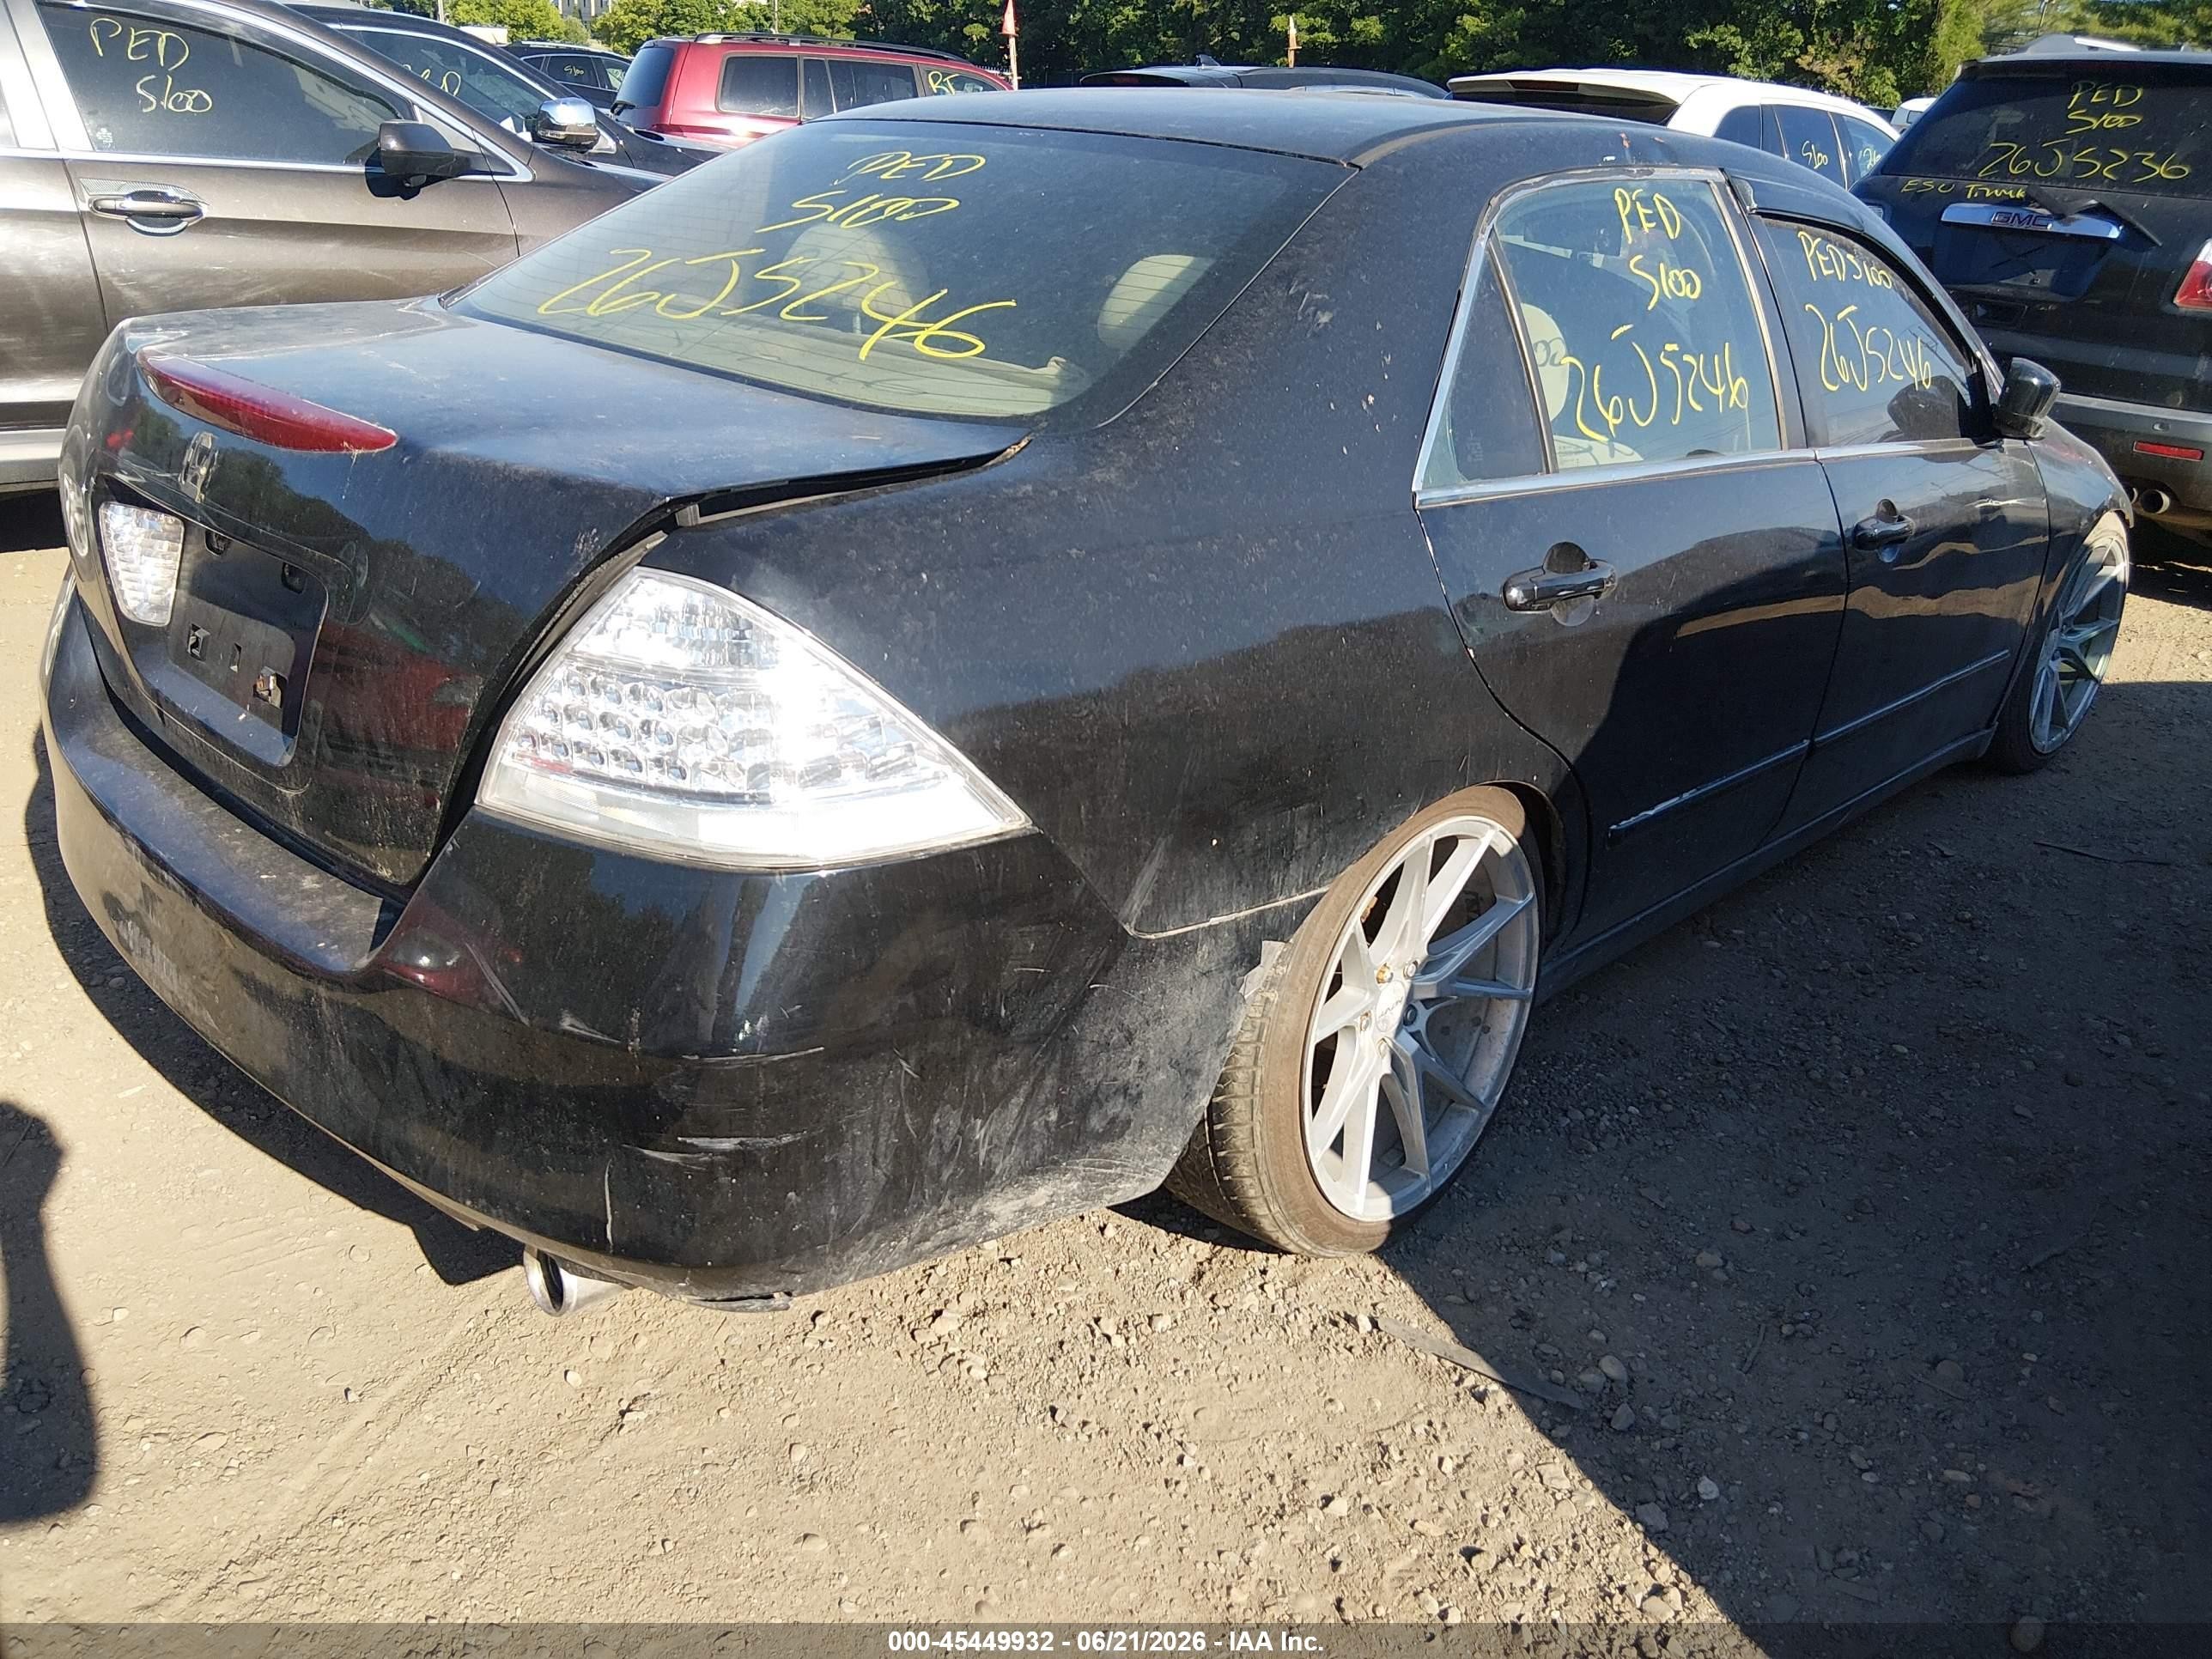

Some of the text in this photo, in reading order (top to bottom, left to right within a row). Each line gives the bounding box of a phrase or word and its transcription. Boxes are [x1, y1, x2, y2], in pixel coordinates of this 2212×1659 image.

[90, 17, 189, 71] PED
[2068, 81, 2143, 109] PED
[834, 151, 986, 185] PED
[1614, 187, 1680, 244] PED
[1990, 211, 2054, 231] GMC
[1798, 231, 1845, 282] PED
